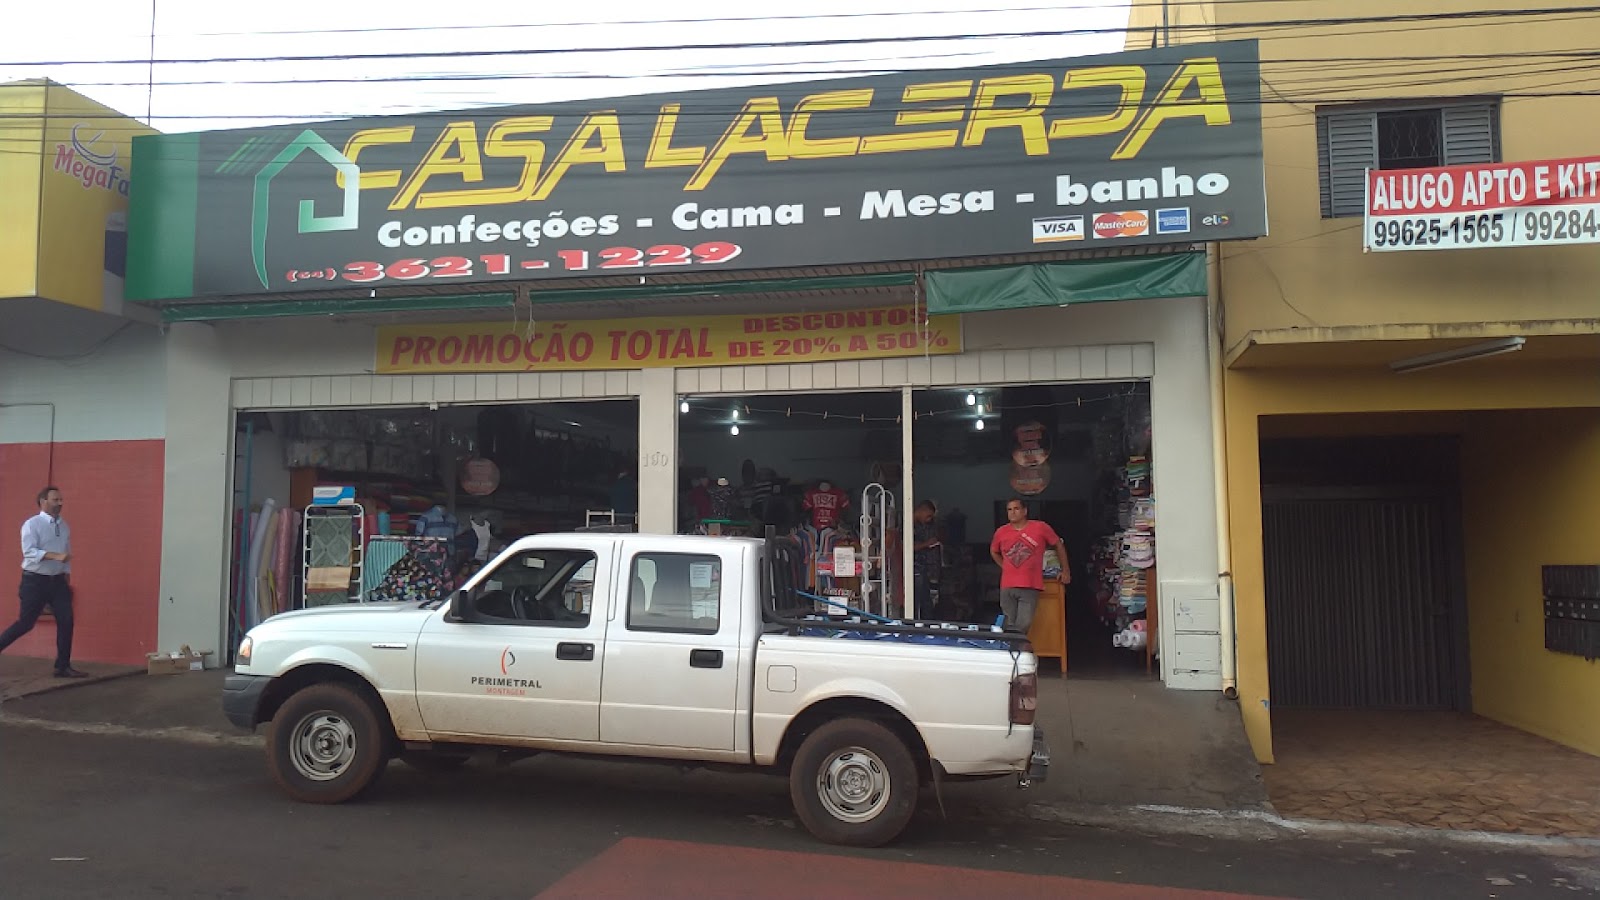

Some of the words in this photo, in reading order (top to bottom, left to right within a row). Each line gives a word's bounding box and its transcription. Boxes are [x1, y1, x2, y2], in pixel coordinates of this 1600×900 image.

[336, 110, 626, 210] CASA
[644, 57, 1232, 191] LACERDA
[1373, 172, 1454, 211] ALUGO
[1461, 168, 1527, 206] APTO
[1534, 166, 1550, 199] E
[1558, 161, 1600, 198] KIT
[377, 210, 619, 247] Confecções
[672, 202, 804, 230] Cama
[860, 189, 994, 219] Mesa
[1056, 166, 1230, 206] banho
[1041, 222, 1077, 234] VISA
[1094, 218, 1148, 231] MasterCard
[1374, 213, 1504, 246] 99625-1565
[1511, 211, 1518, 242] /
[341, 241, 742, 283] 3621-1229
[743, 307, 927, 334] DESCONTOS
[390, 322, 595, 371] PROMOÇÃO
[608, 327, 713, 361] TOTAL
[728, 340, 766, 358] DE
[773, 336, 841, 356] 20%
[848, 335, 869, 352] A
[877, 330, 949, 350] 50%
[471, 676, 542, 689] PERIMETRAL
